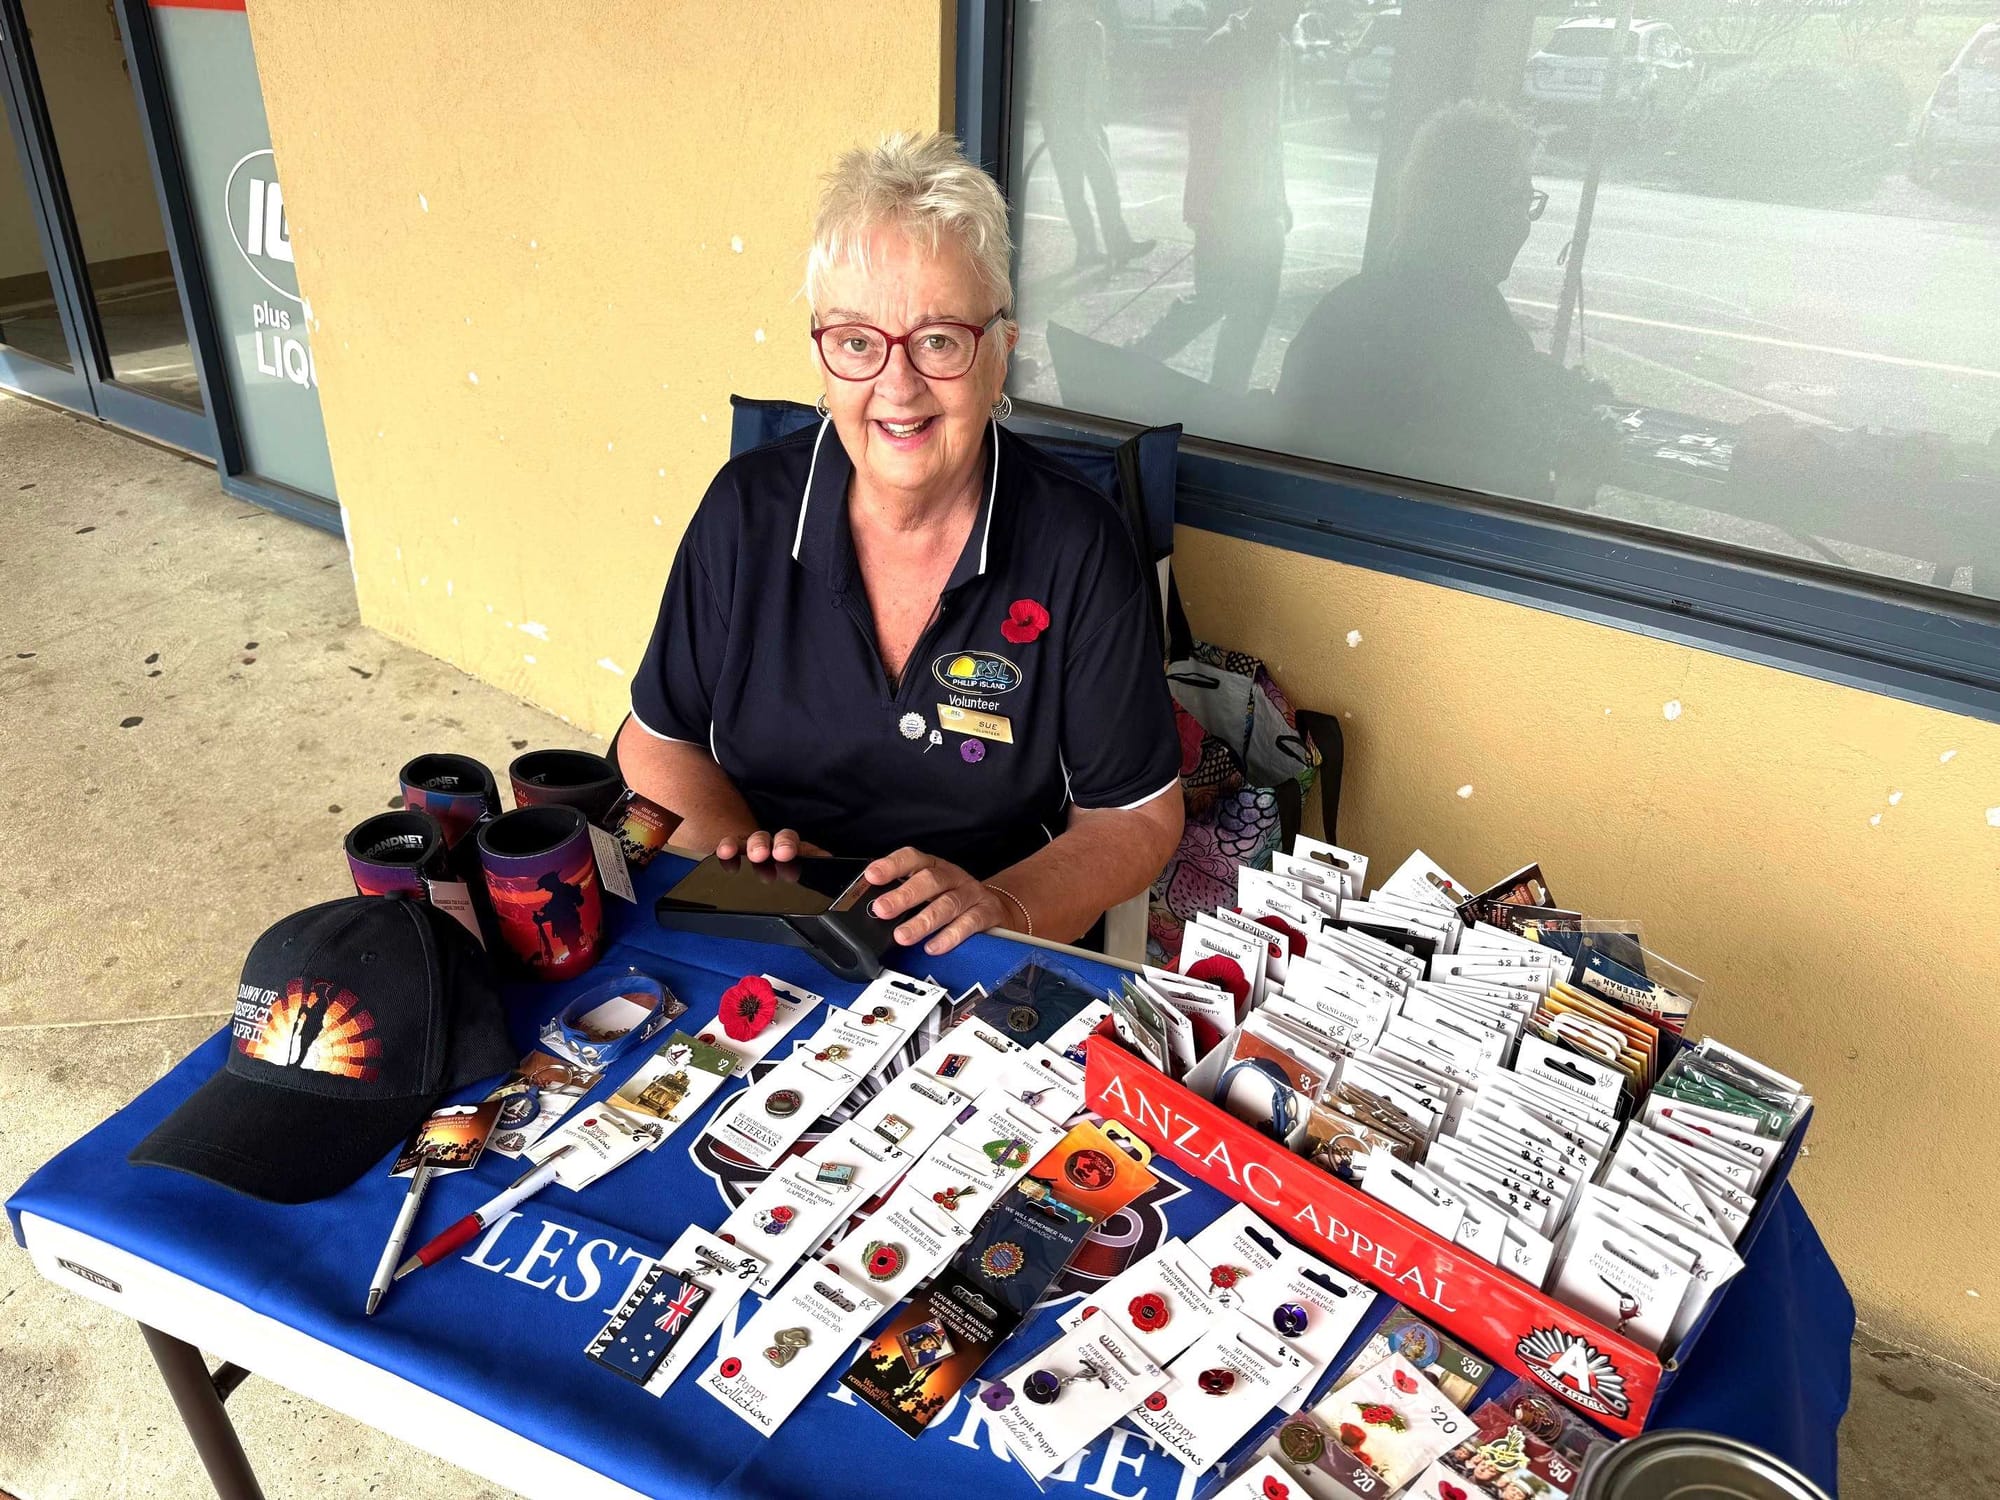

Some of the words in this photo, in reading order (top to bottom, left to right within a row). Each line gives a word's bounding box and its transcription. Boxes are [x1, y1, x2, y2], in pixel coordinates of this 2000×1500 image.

[253, 300, 291, 331] plus
[953, 678, 978, 687] PHILLIP
[980, 681, 1006, 690] ISLAND
[949, 694, 1000, 711] Volunteer
[979, 721, 998, 730] SUE
[1497, 959, 1512, 967] $8
[1387, 978, 1401, 992] $8
[1527, 974, 1541, 982] $8
[1601, 986, 1615, 996] OF
[1603, 978, 1648, 1000] VETERAN
[238, 983, 262, 1003] DAWN
[261, 988, 279, 1006] OF
[1515, 993, 1529, 1001] $8
[1620, 993, 1659, 1010] FAMILY
[1198, 1007, 1221, 1016] POPPY
[1317, 1002, 1341, 1016] STAND
[1338, 1012, 1360, 1025] DOWN
[838, 1035, 855, 1045] LAPEL
[842, 1030, 860, 1041] FORCE
[860, 1036, 879, 1047] POPPY
[1328, 1026, 1345, 1037] $8
[1351, 1032, 1370, 1047] $7
[718, 1058, 729, 1072] $2
[1023, 1060, 1044, 1077] PURPLE
[1044, 1073, 1062, 1089] POPPY
[1061, 1086, 1080, 1100] LAPEL
[1299, 1073, 1311, 1090] $3
[733, 1116, 779, 1147] VETERANS
[988, 1117, 1011, 1133] LAUREL
[993, 1112, 1007, 1124] LEST
[1006, 1120, 1016, 1129] WE
[1015, 1125, 1038, 1145] FORGET
[1733, 1138, 1765, 1157] $20
[935, 1159, 952, 1172] STEM
[951, 1166, 973, 1181] POPPY
[972, 1176, 994, 1191] BADGE
[780, 1176, 815, 1198] TRI-COLOUR
[814, 1194, 835, 1207] POPPY
[786, 1187, 806, 1201] LAPEL
[805, 1198, 818, 1206] PIN
[1099, 1075, 1281, 1208] ANZAC
[1291, 1203, 1456, 1313] APPEAL
[1727, 1190, 1749, 1204] $15
[886, 1215, 912, 1237] SERVICE
[910, 1233, 928, 1248] LAPEL
[927, 1246, 939, 1257] PIN
[893, 1211, 925, 1238] REMEMBER
[924, 1234, 942, 1250] THEIR
[1005, 1206, 1016, 1214] WE
[1014, 1211, 1028, 1222] WILL
[1027, 1218, 1058, 1236] REMEMBER
[1057, 1233, 1074, 1244] THEM
[460, 1210, 664, 1317] LEST
[1232, 1242, 1253, 1261] LAPEL
[1251, 1258, 1265, 1270] PIN
[1235, 1234, 1257, 1254] POPPY
[1254, 1251, 1273, 1269] STEM
[1593, 1252, 1625, 1278] PURPLE
[1157, 1259, 1203, 1305] REMEMBRANCE
[1201, 1302, 1214, 1316] DAY
[1159, 1271, 1180, 1292] POPPY
[1178, 1290, 1199, 1312] BADGE
[1296, 1280, 1306, 1289] 3D
[1304, 1284, 1335, 1306] PURPLE
[1348, 1285, 1373, 1299] $15
[1589, 1258, 1619, 1284] COLLAR
[1619, 1281, 1655, 1302] CHARM
[589, 1267, 664, 1359] VETERAN
[804, 1294, 825, 1310] STAND
[823, 1307, 843, 1323] DOWN
[1287, 1283, 1312, 1302] POPPY
[1310, 1297, 1336, 1315] BADGE
[791, 1297, 812, 1313] POPPY
[811, 1309, 832, 1326] LAPEL
[830, 1322, 843, 1333] PIN
[928, 1307, 965, 1334] REMEMBER
[964, 1331, 978, 1344] PIN
[933, 1291, 965, 1316] COURAGE,
[965, 1311, 994, 1337] HONOUR,
[963, 1320, 990, 1342] ALWAYS
[1086, 1342, 1109, 1367] PURPLE
[1108, 1364, 1131, 1386] POPPY
[1216, 1344, 1271, 1386] RECOLLECTIONS
[1220, 1356, 1243, 1375] LAPEL
[1240, 1373, 1255, 1384] PIN
[1233, 1347, 1243, 1355] 3D
[1241, 1352, 1266, 1371] POPPY
[1460, 1356, 1483, 1379] $30
[736, 1374, 768, 1402] Poppy
[848, 1374, 882, 1402] remember
[863, 1376, 876, 1388] We
[873, 1385, 890, 1399] will
[1102, 1369, 1125, 1392] CHARM
[1534, 1367, 1565, 1393] ANZAC
[1565, 1388, 1604, 1412] APPEAL
[709, 1374, 773, 1427] Recollections
[999, 1413, 1034, 1453] collection
[1010, 1405, 1036, 1434] Purple
[1033, 1427, 1059, 1459] Poppy
[1161, 1410, 1197, 1441] Poppy
[1430, 1405, 1458, 1434] $20
[1134, 1404, 1204, 1466] Recollections
[1353, 1468, 1376, 1493] $20
[1548, 1458, 1572, 1483] $50
